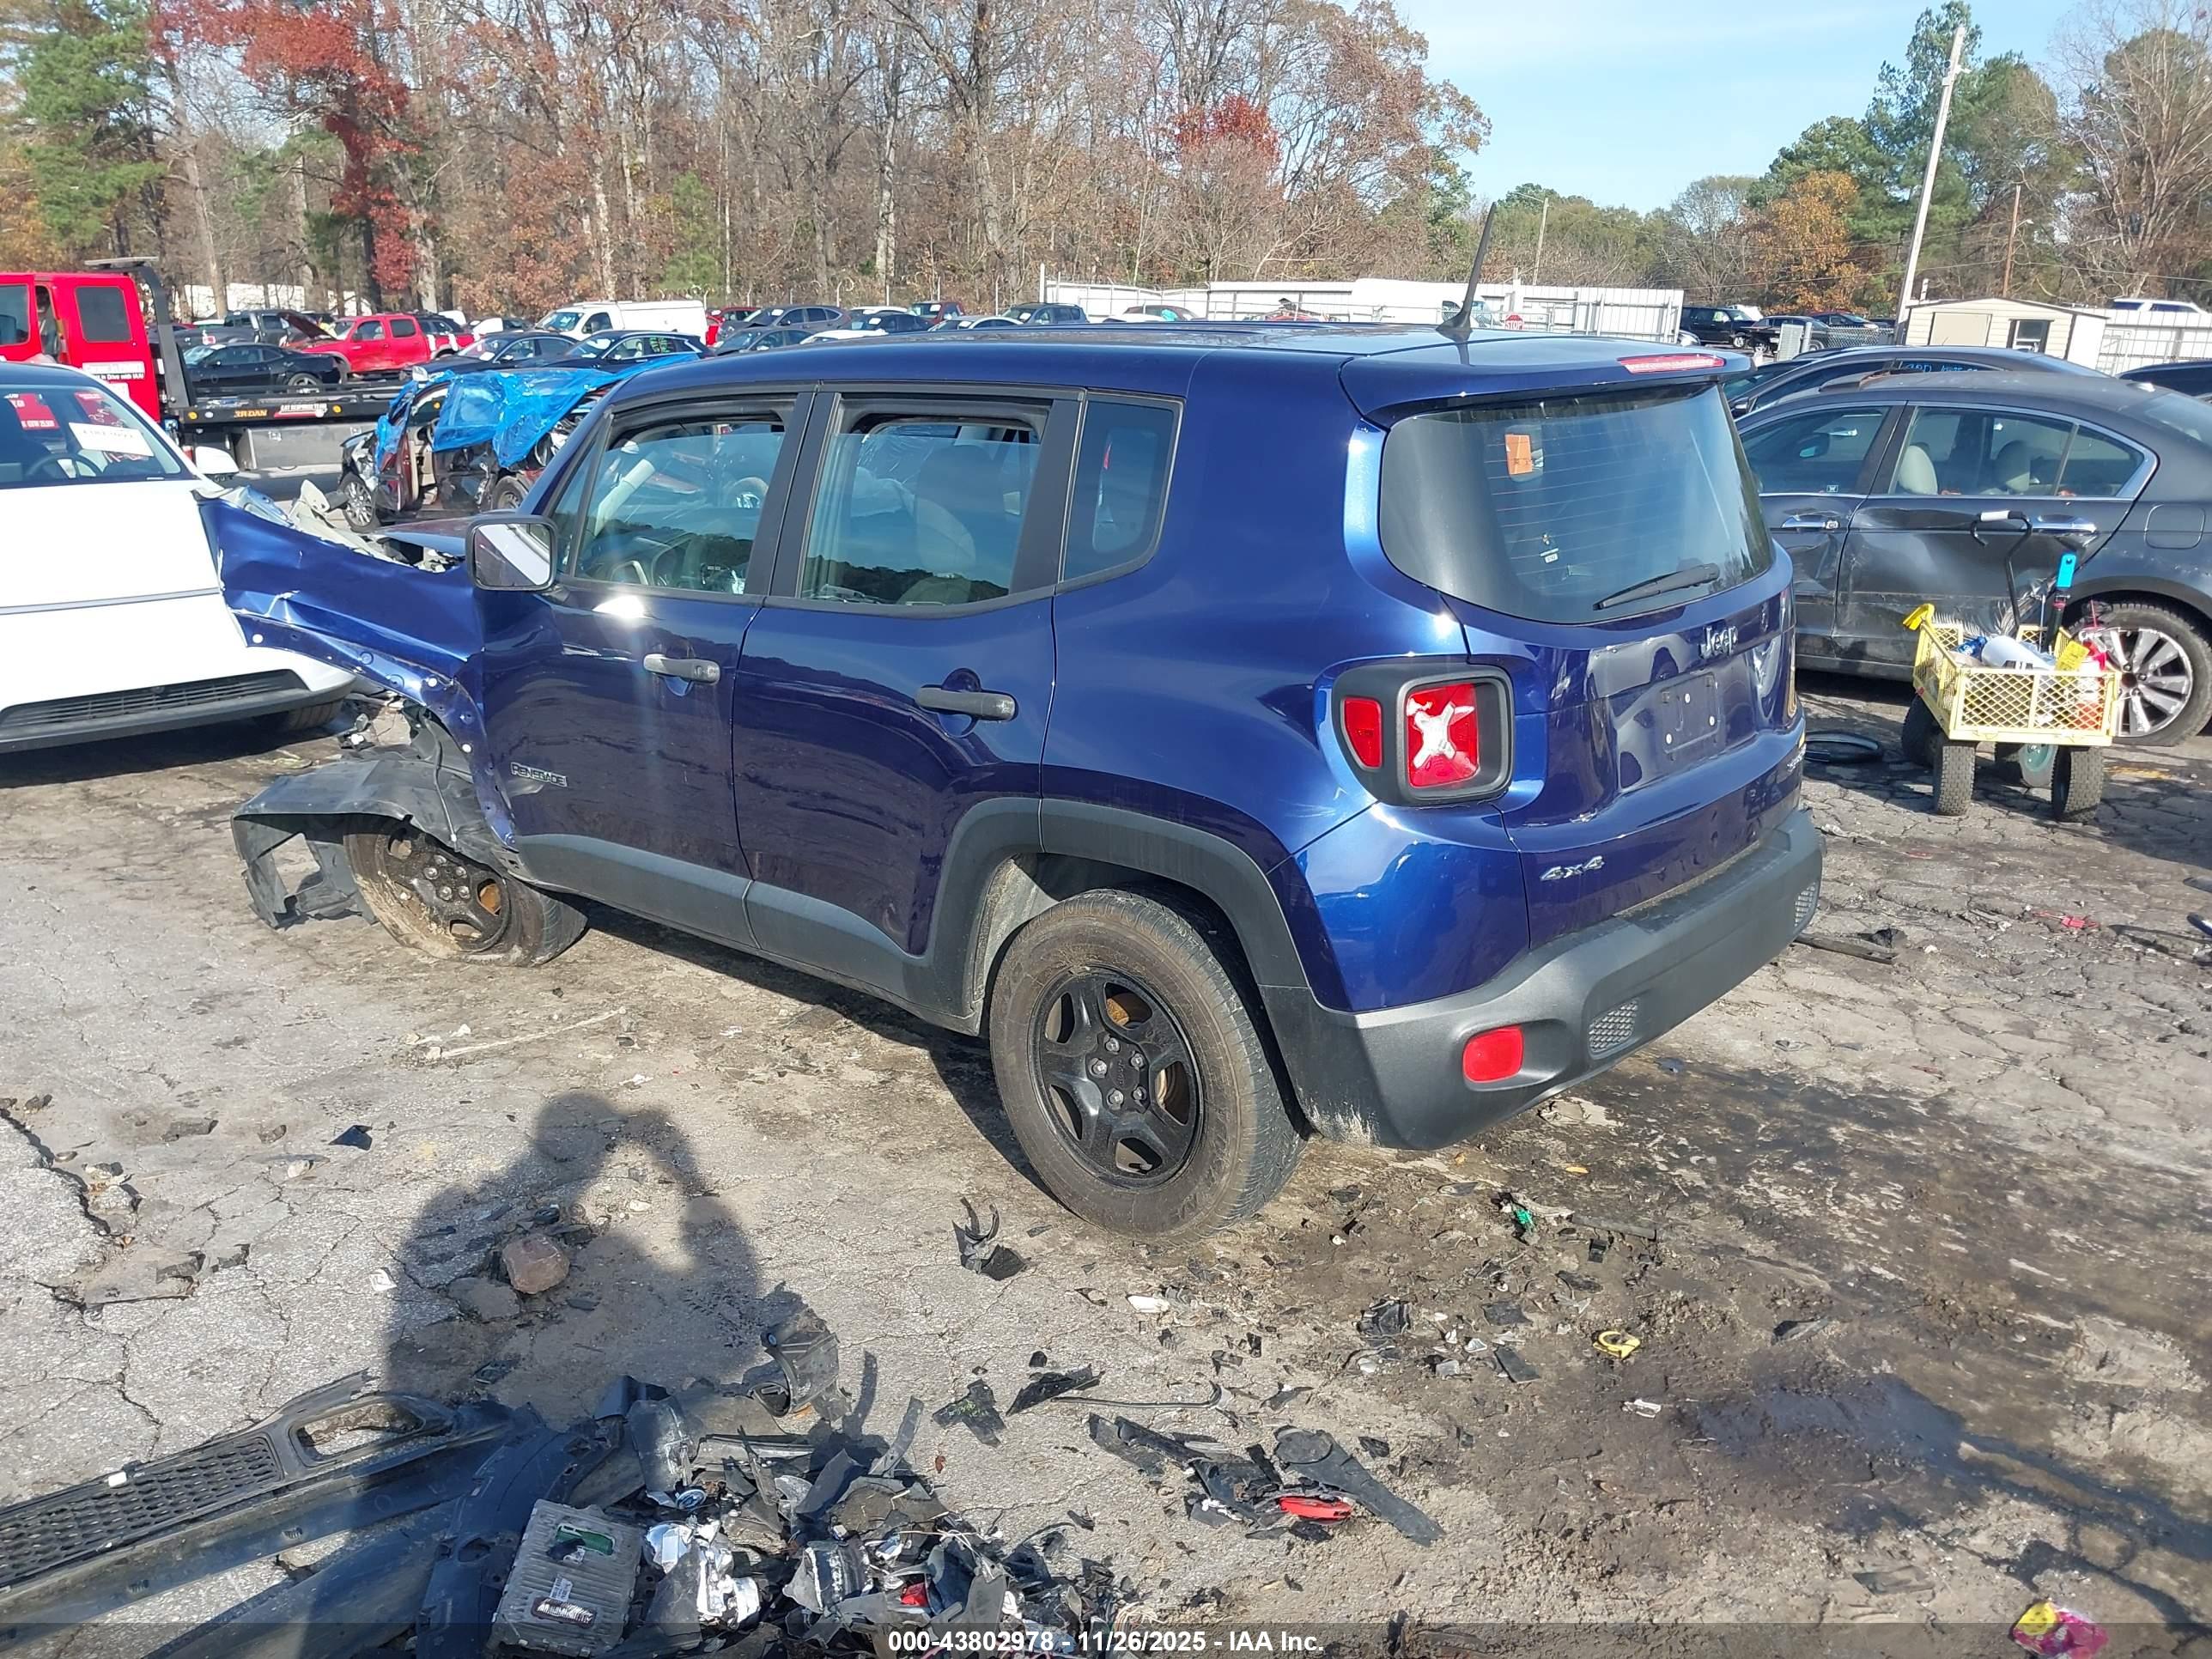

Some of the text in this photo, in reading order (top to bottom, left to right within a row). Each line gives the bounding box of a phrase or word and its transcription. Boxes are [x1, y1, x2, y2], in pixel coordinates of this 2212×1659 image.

[1505, 320, 1522, 330] STOP
[1698, 626, 1738, 659] Jeep
[511, 762, 568, 787] RENEGADE
[1540, 855, 1605, 881] 4x4
